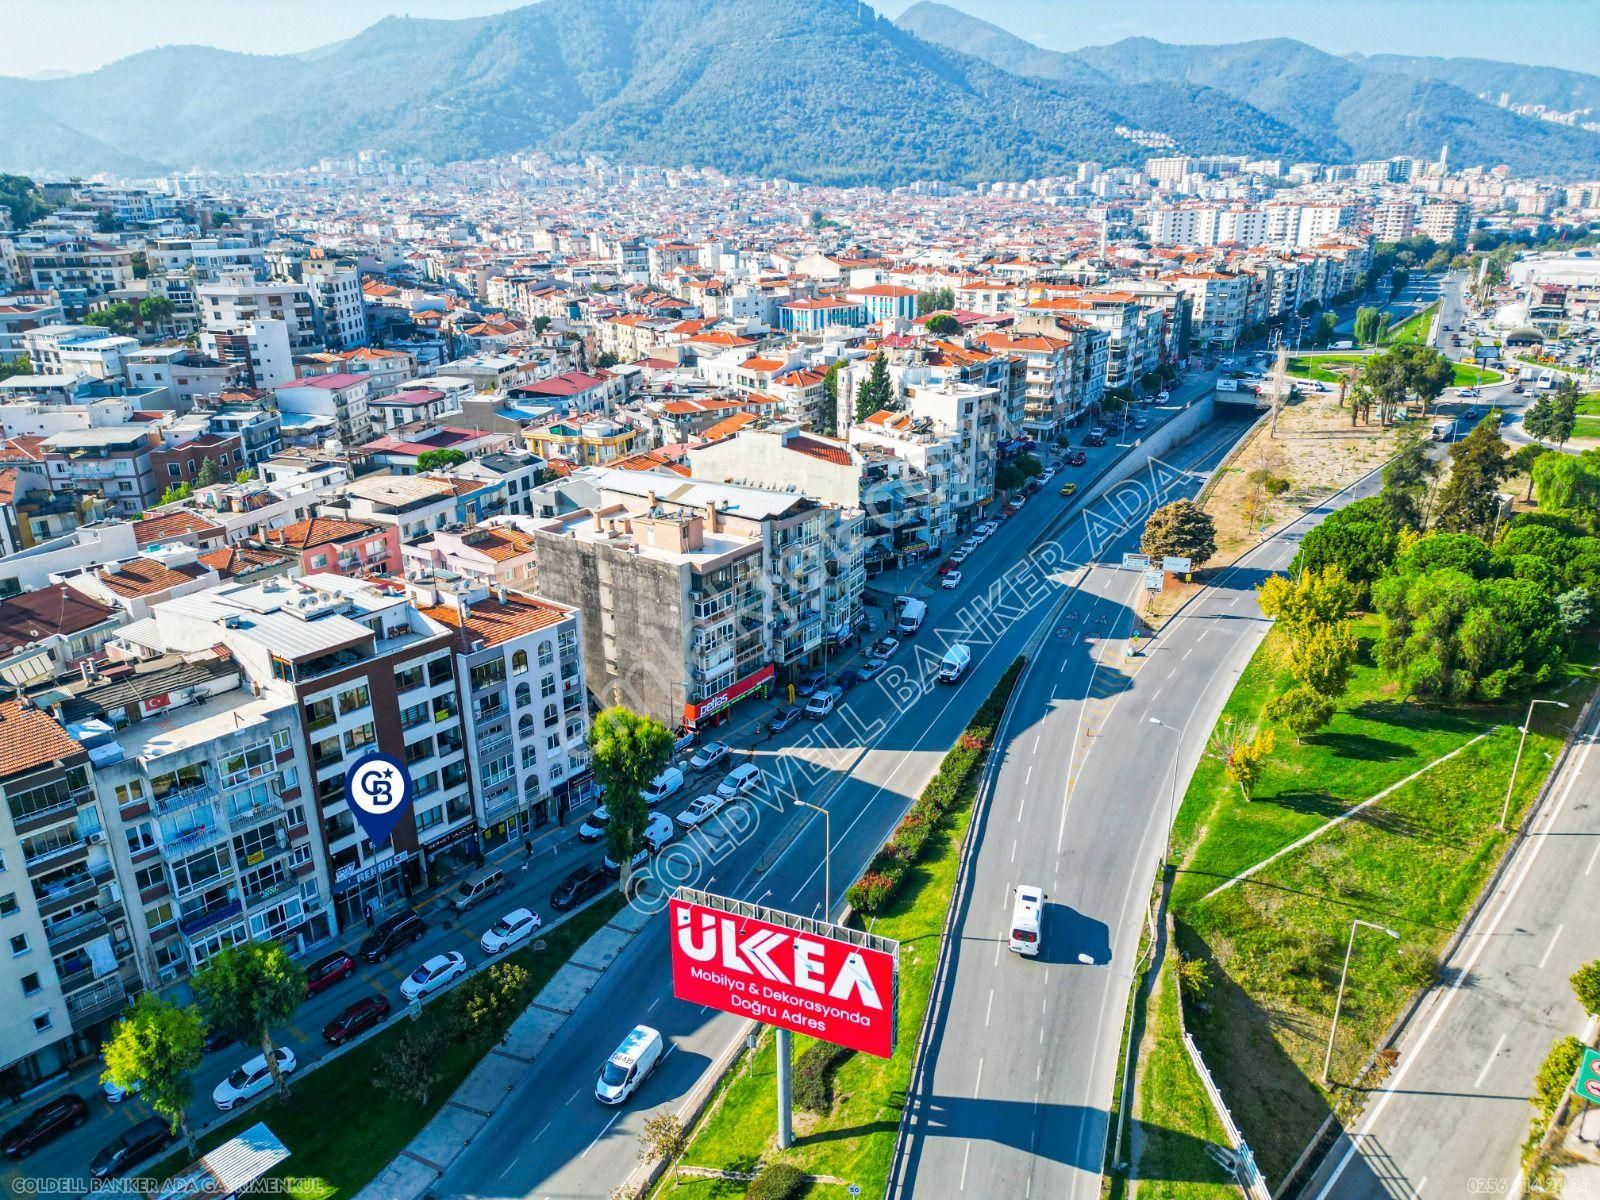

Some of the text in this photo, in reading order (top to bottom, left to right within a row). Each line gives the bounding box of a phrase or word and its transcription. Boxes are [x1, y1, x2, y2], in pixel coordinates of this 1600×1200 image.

[691, 966, 871, 1027] Mobilya & Dekorasyonda
[731, 994, 826, 1031] Doğru Adres
